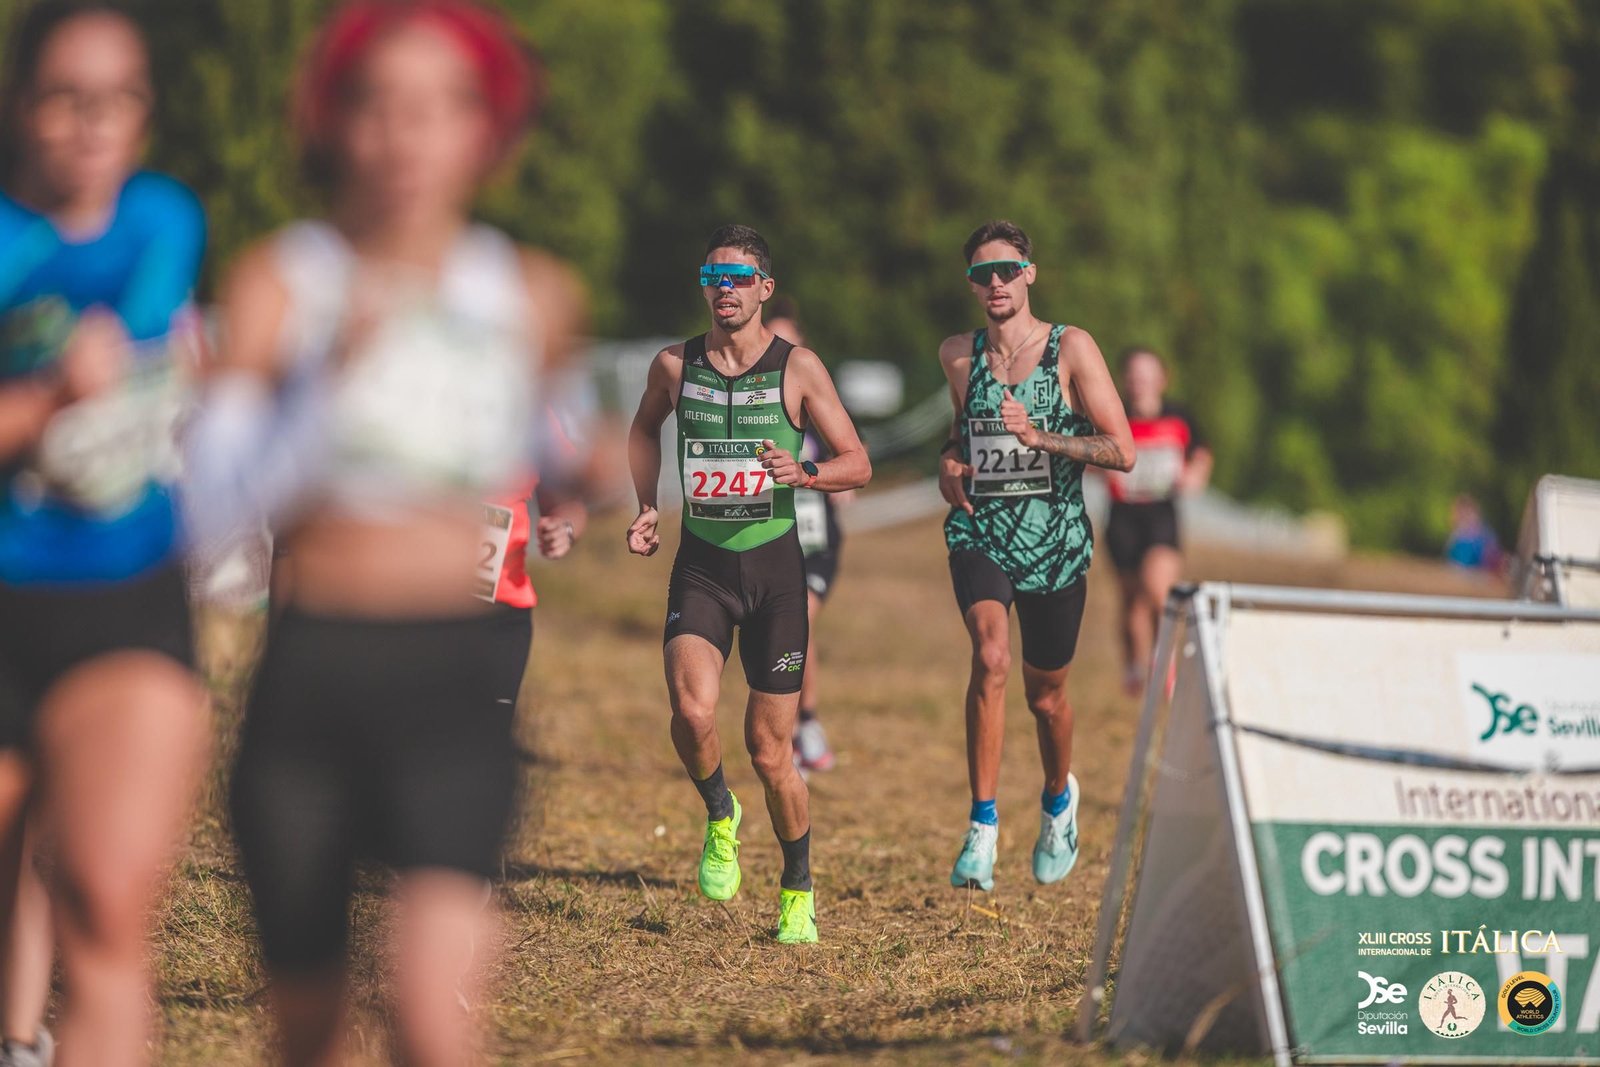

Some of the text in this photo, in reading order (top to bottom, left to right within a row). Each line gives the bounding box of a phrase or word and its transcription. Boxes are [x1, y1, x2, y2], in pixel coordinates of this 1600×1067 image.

[684, 410, 779, 425] ATLETISMO CORDOBÉS
[708, 442, 750, 454] ITÁLICA
[977, 448, 1044, 474] 2212
[692, 470, 767, 498] 2247
[1302, 832, 1509, 899] CROSS
